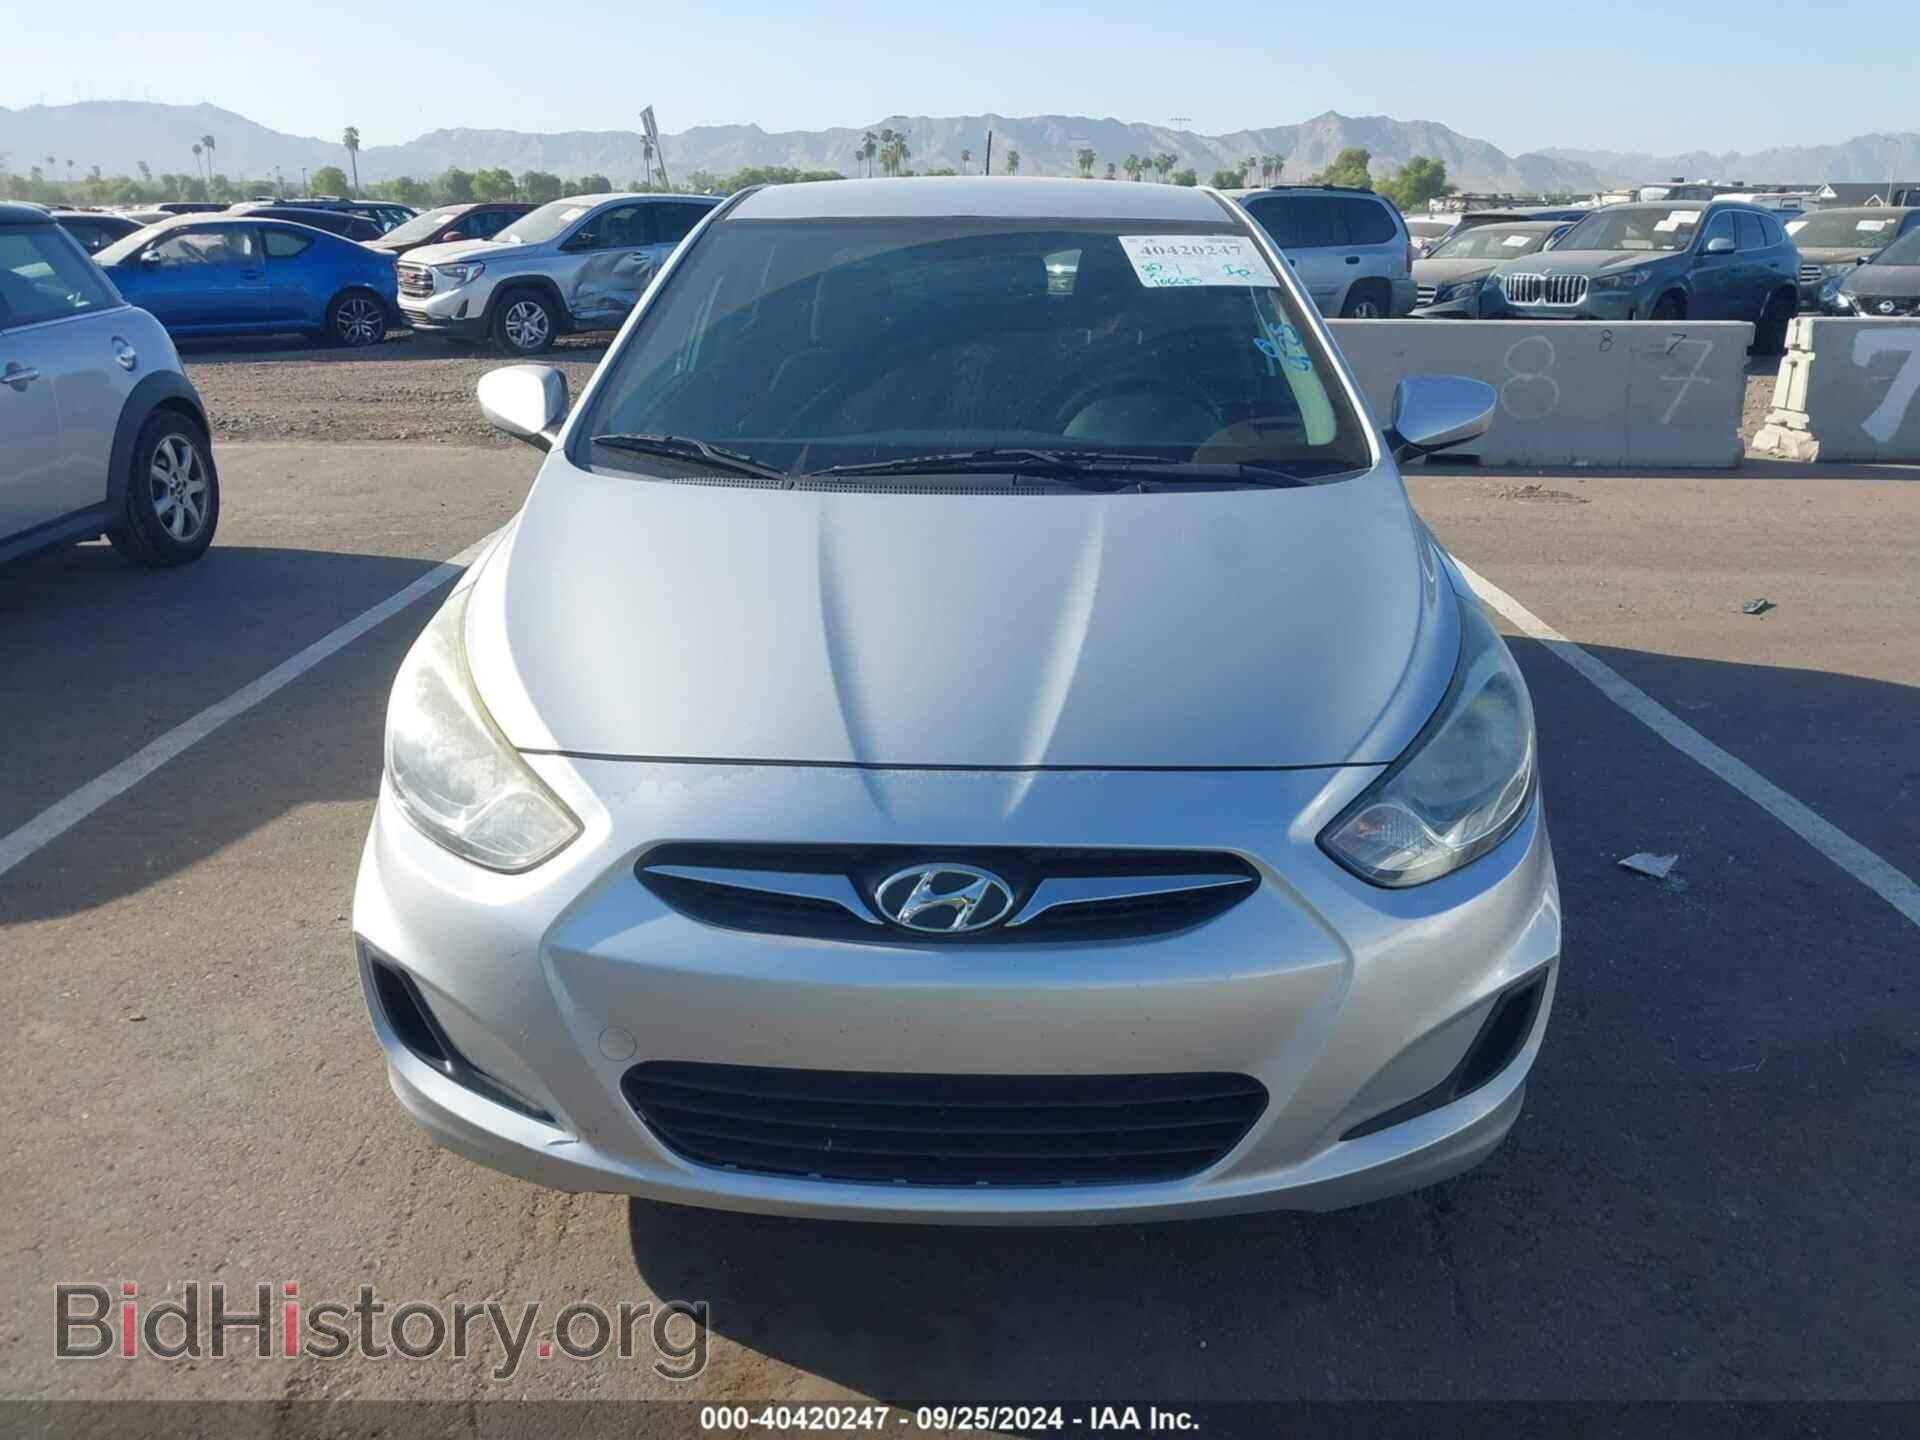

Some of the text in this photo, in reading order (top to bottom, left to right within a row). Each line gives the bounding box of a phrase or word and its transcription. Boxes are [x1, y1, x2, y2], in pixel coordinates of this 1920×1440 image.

[1140, 245, 1241, 256] 40420247
[1600, 329, 1687, 355] 8 7
[1501, 335, 1713, 424] 8 7
[1851, 327, 1920, 443] 7
